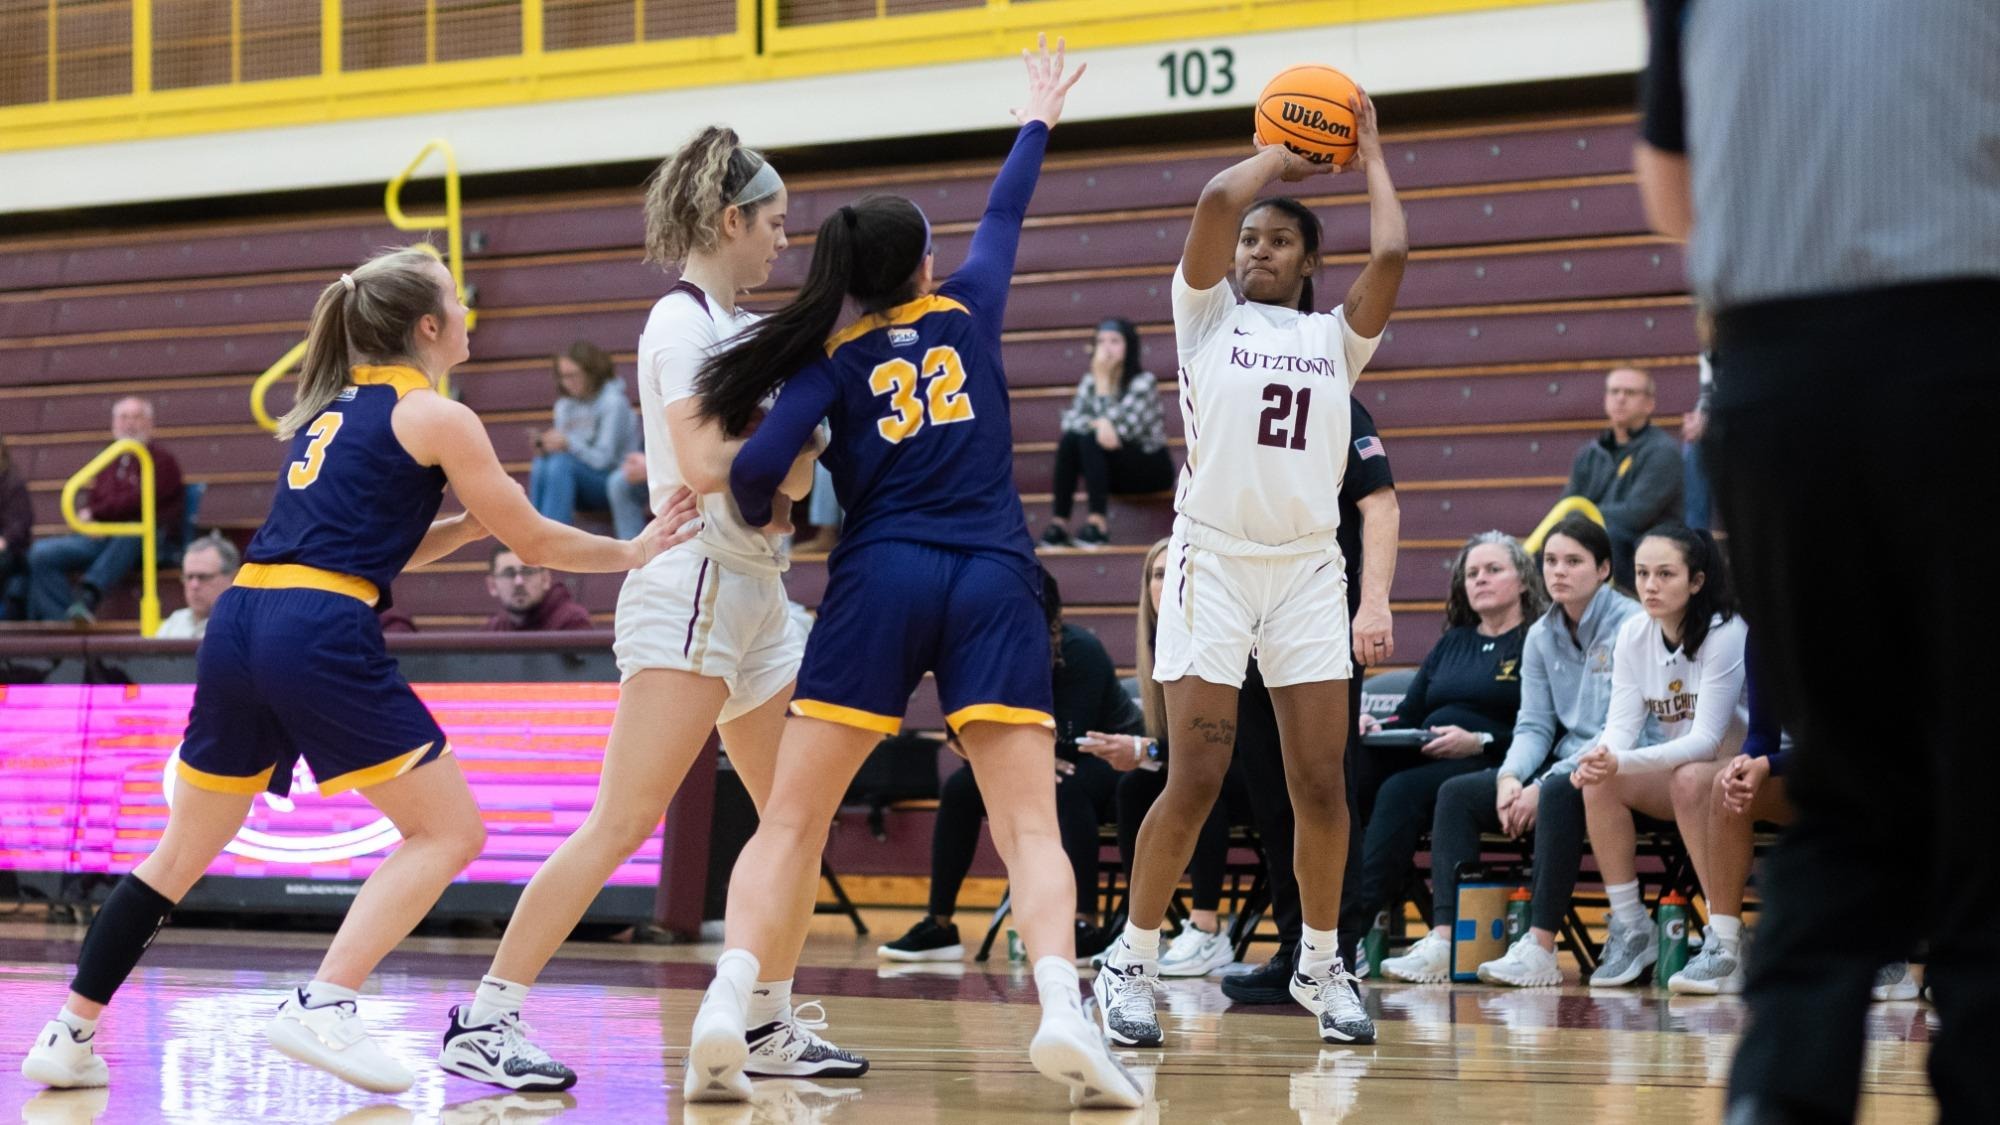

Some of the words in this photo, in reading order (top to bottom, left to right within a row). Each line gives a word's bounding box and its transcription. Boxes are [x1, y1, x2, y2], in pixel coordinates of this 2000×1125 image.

[1159, 47, 1236, 97] 103
[1282, 102, 1350, 139] Wilson
[1230, 346, 1336, 378] KUTZTOWN
[868, 344, 975, 444] 32
[1257, 383, 1311, 451] 21
[287, 411, 343, 490] 3
